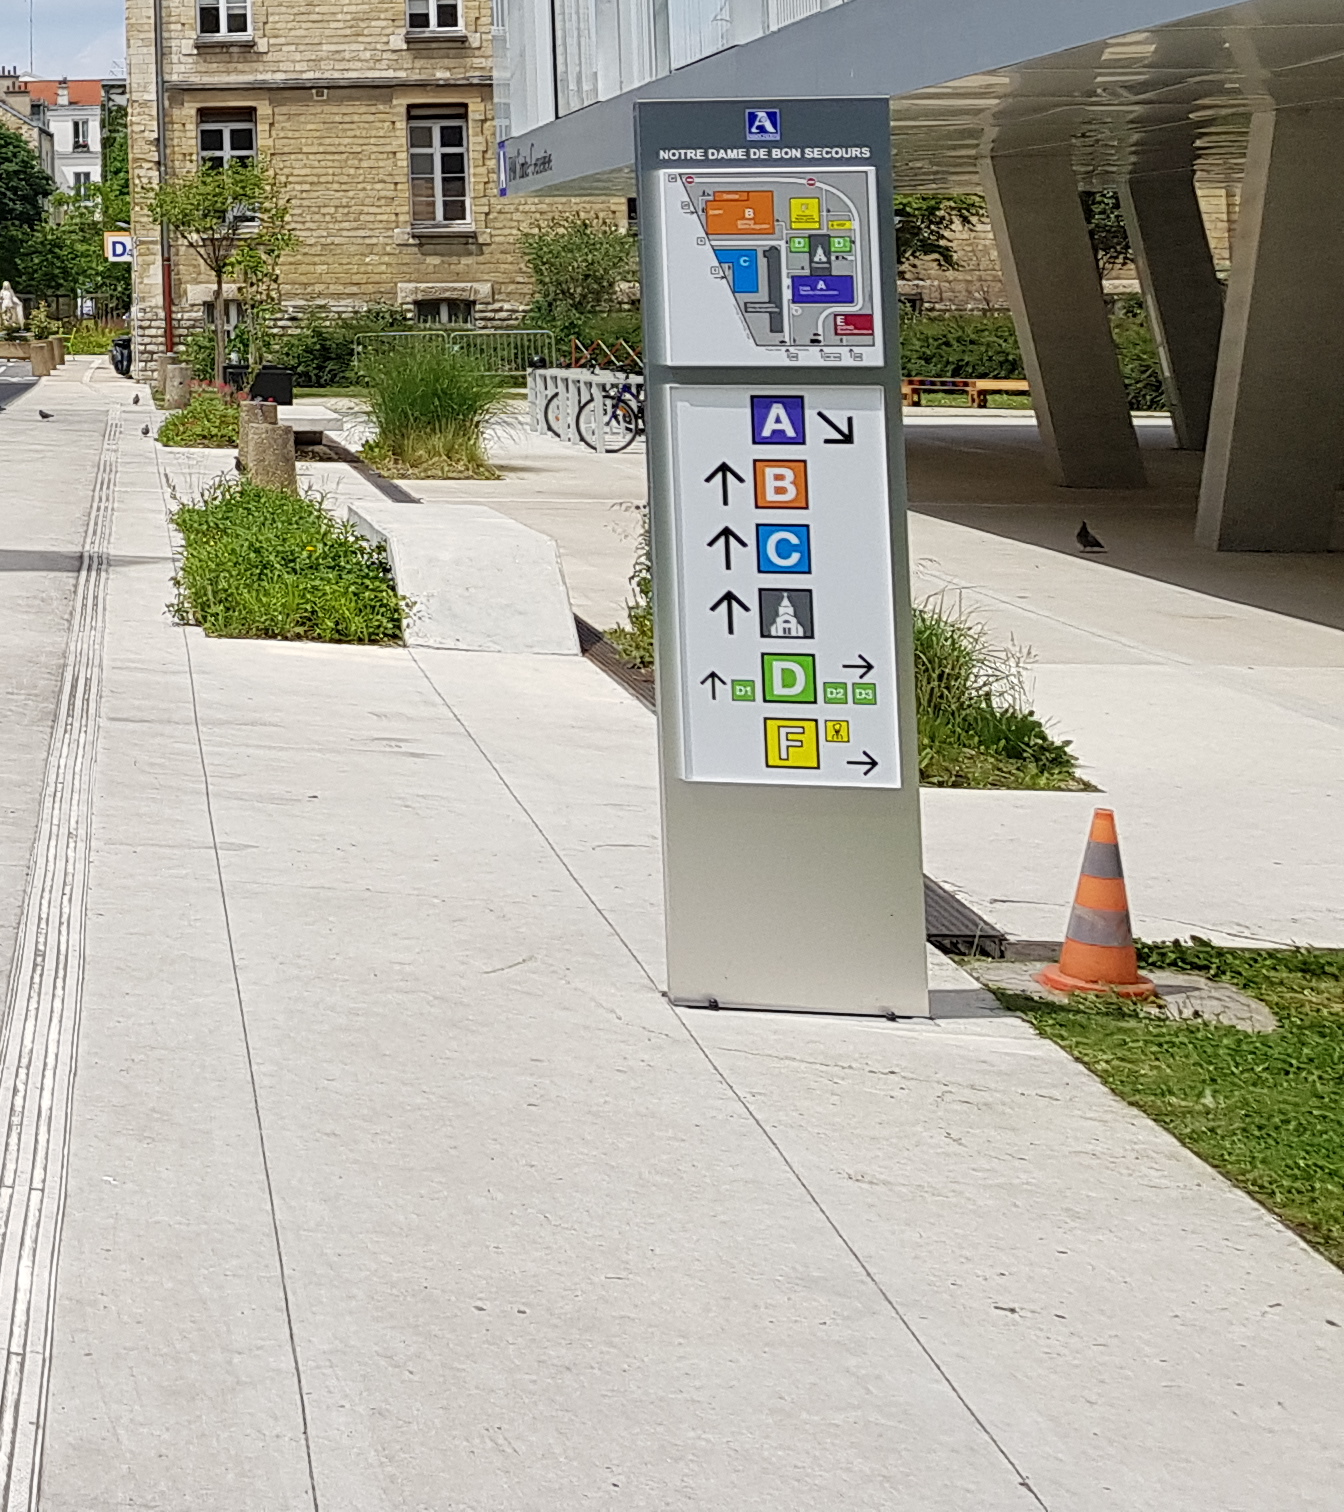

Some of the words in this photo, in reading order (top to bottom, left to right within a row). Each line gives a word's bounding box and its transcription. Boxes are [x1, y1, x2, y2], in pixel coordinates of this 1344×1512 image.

[751, 112, 777, 133] A
[659, 149, 705, 160] NOTRE
[708, 149, 747, 159] DAME
[750, 148, 769, 159] DE
[772, 148, 801, 158] BON
[804, 147, 871, 158] SECOURS
[744, 208, 754, 219] B
[740, 256, 750, 266] C
[817, 280, 826, 289] A
[836, 316, 845, 325] E
[761, 403, 795, 437] A
[765, 467, 797, 502] B
[766, 531, 802, 566] C
[736, 684, 752, 696] D1
[773, 661, 806, 695] D
[827, 687, 844, 699] D2
[856, 688, 873, 700] D3
[778, 726, 804, 761] F
